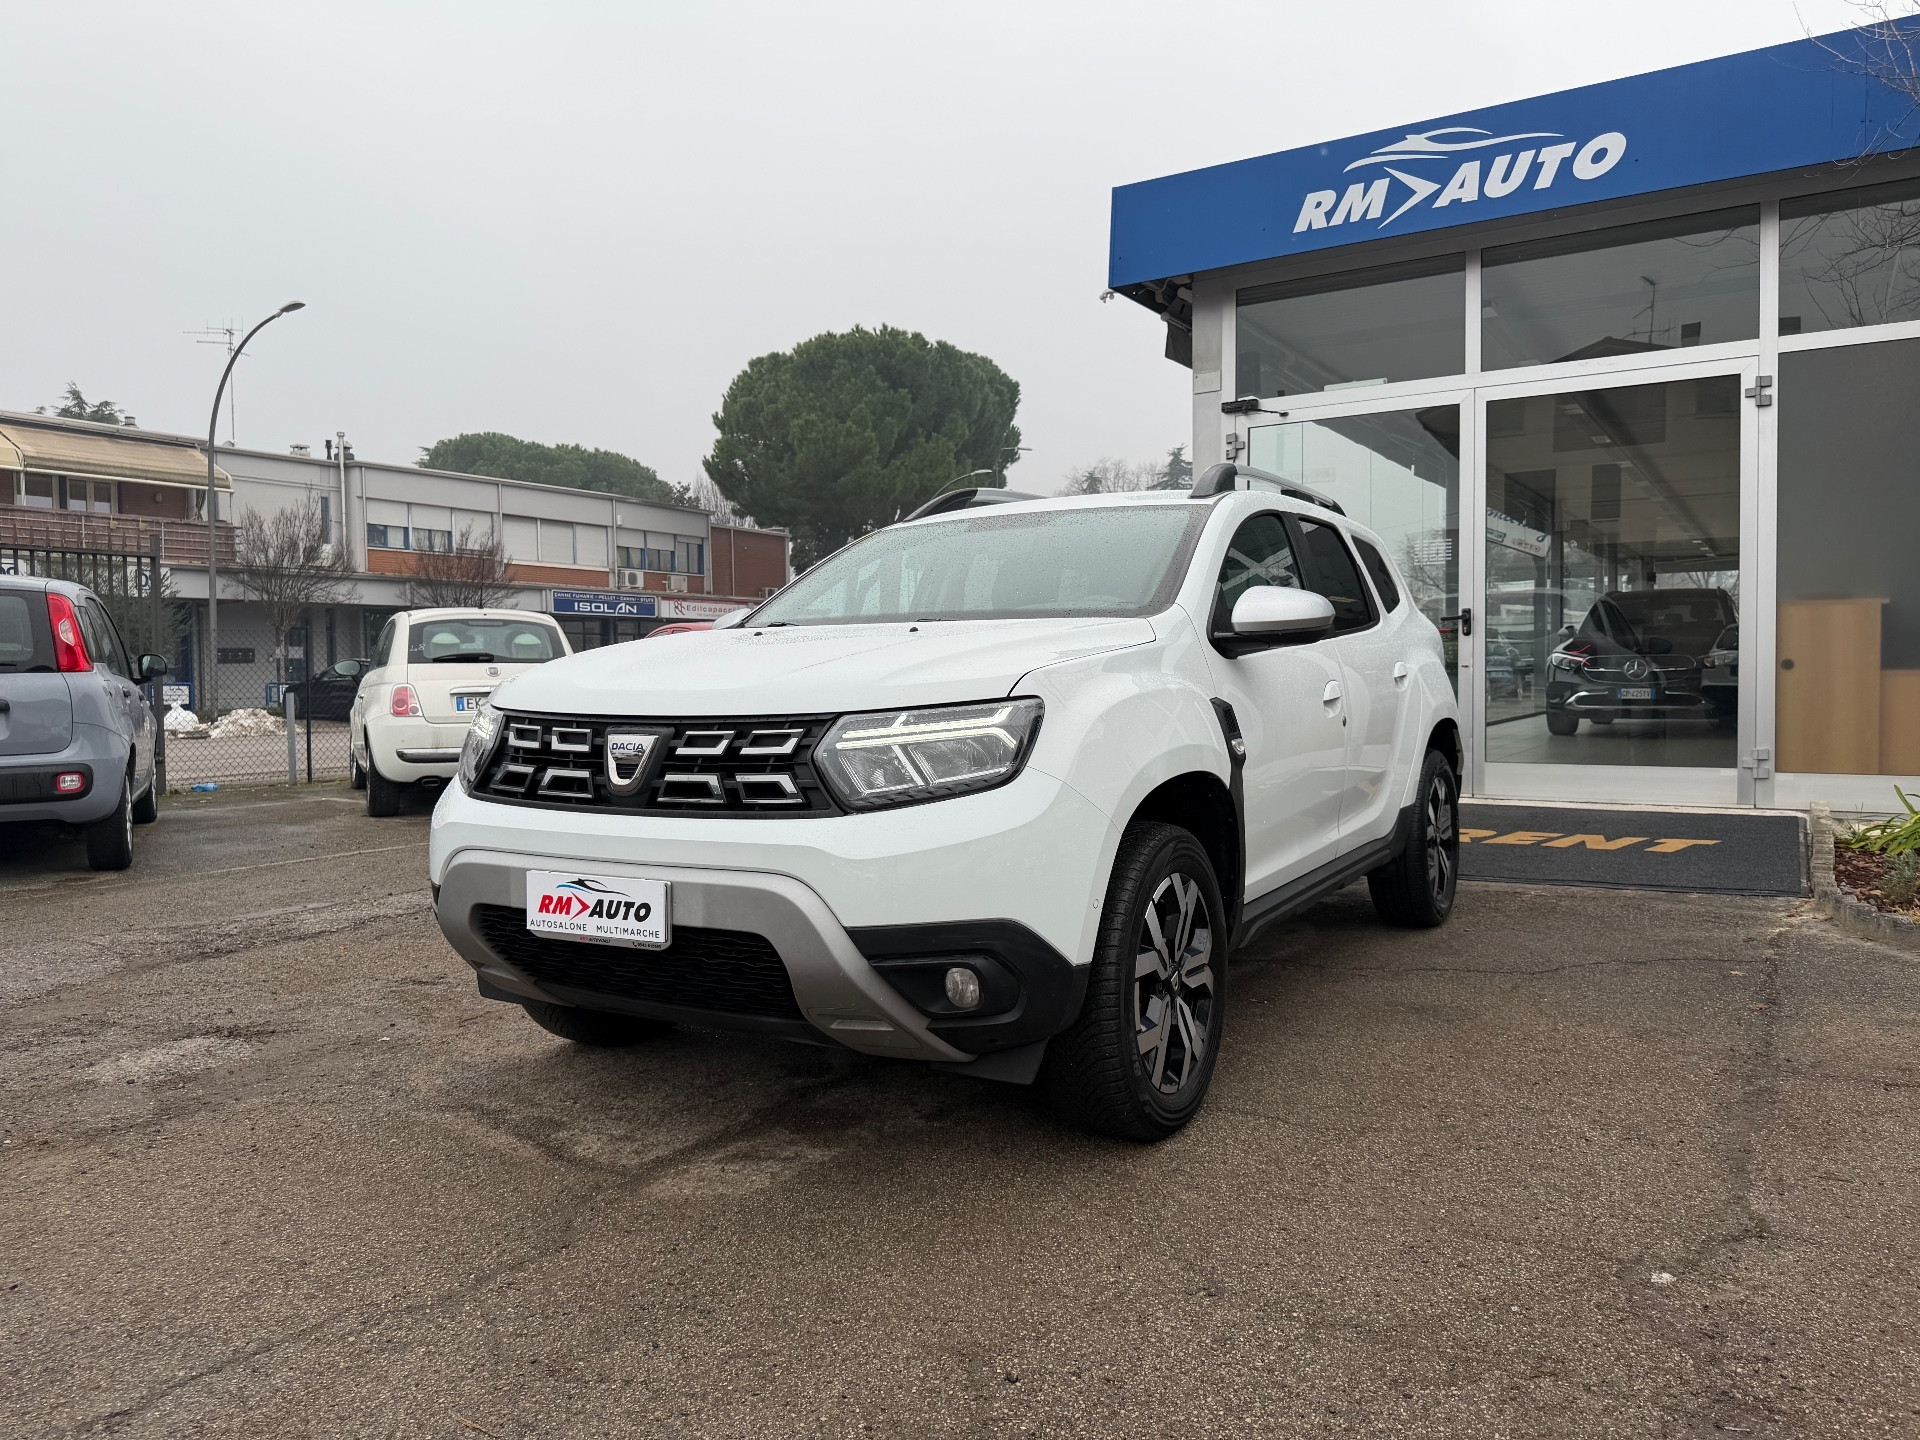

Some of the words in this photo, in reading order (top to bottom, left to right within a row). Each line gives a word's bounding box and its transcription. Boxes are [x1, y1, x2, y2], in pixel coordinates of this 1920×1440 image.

[1292, 177, 1390, 233] RM
[1431, 131, 1627, 209] AUTO
[574, 602, 637, 615] ISOLAN
[611, 742, 644, 751] DACIA
[538, 894, 573, 915] RM
[588, 898, 651, 922] AUTO
[529, 919, 587, 932] AUTOSALONE
[596, 925, 660, 939] MULTIMARCHE
